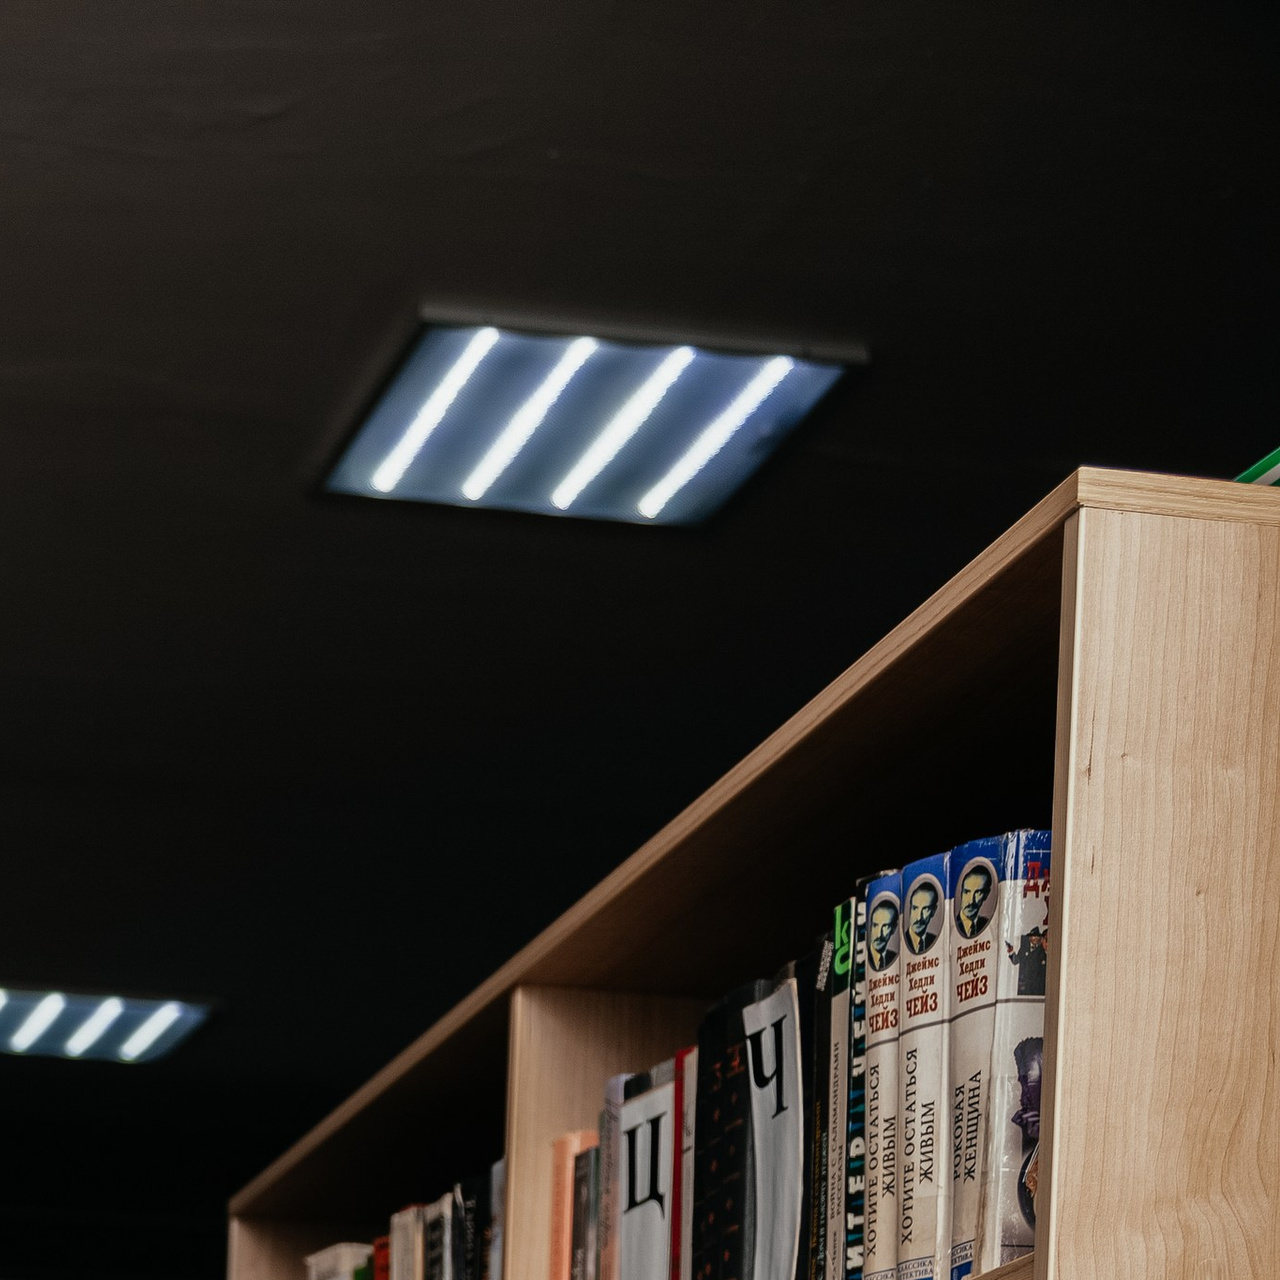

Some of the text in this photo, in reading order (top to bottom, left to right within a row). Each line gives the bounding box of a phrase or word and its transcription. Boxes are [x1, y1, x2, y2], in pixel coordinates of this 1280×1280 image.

[906, 955, 939, 978] Джеймс
[956, 939, 991, 962] Джеймс
[959, 957, 986, 976] Хедли
[868, 972, 900, 993] Джеймс
[908, 974, 935, 992] Хедли
[956, 972, 988, 1004] ЧЕЙЗ
[870, 991, 895, 1009] Хедли
[906, 988, 938, 1018] ЧЕЙЗ
[868, 1004, 898, 1034] ЧЕЙЗ
[746, 1014, 788, 1119] Ч
[919, 1100, 935, 1183] ЖИВЫМ
[953, 1083, 966, 1181] РОКОВАЯ
[963, 1069, 982, 1184] ЖЕНЩИНА
[867, 1063, 880, 1257] ХОТИТЕ ОСТАТЬСЯ
[882, 1115, 897, 1197] ЖИВЫМ
[901, 1048, 918, 1245] ХОТИТЕ ОСТАТЬСЯ
[624, 1112, 667, 1219] Ц
